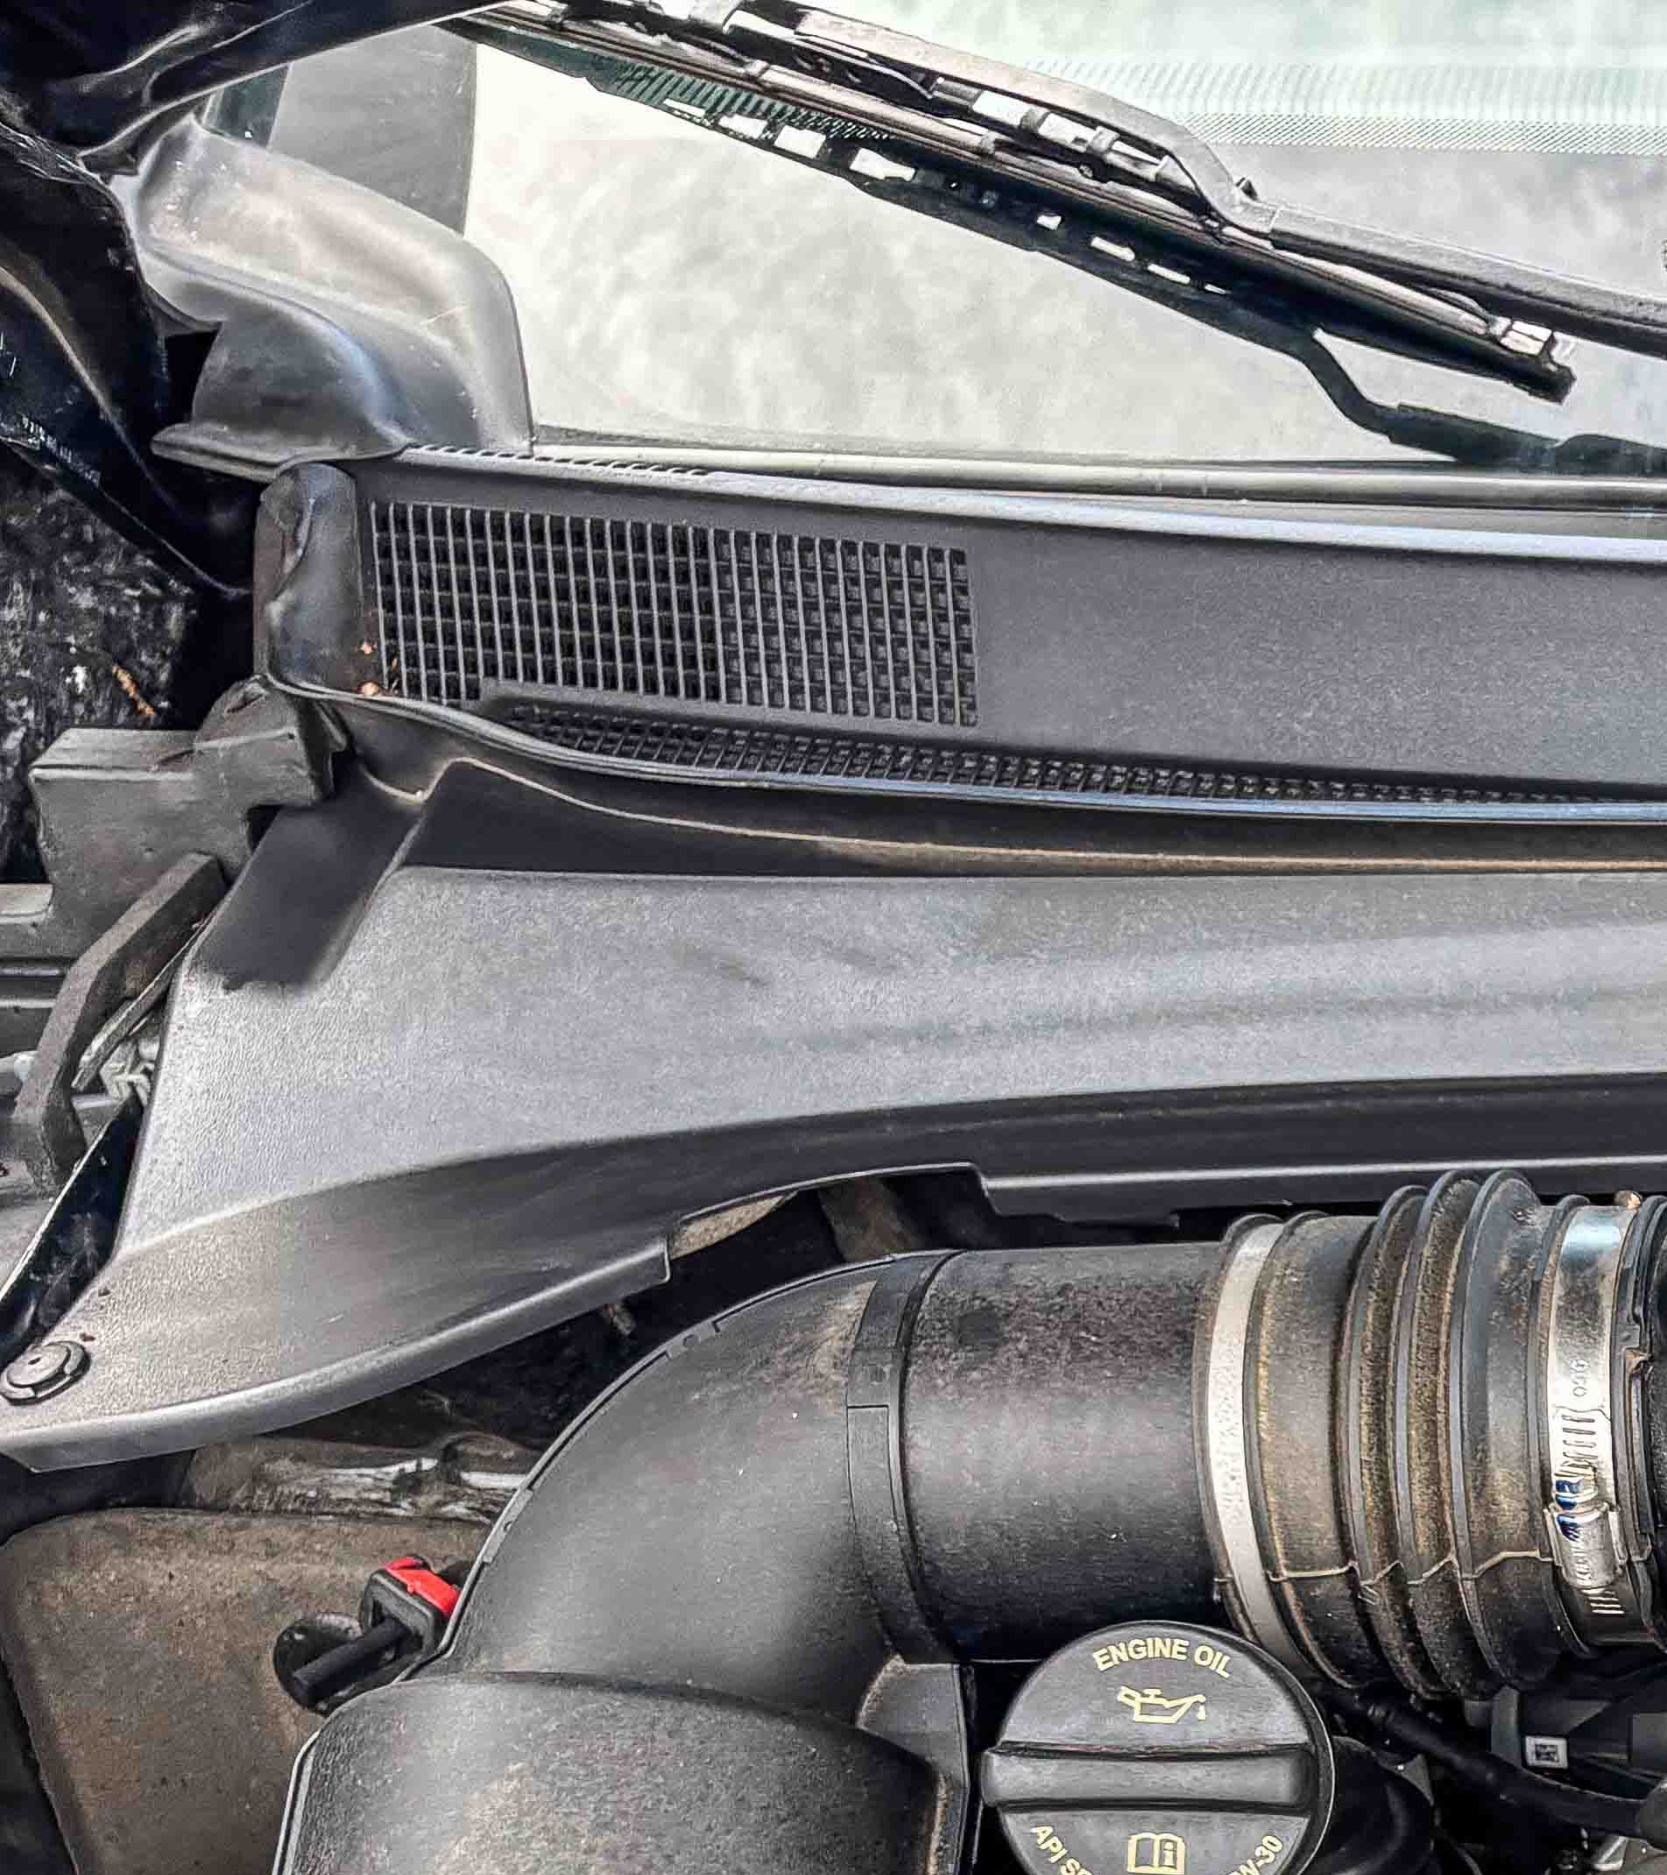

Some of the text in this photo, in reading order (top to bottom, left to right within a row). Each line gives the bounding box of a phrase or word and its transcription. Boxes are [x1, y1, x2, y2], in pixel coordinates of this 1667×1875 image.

[1092, 1637, 1232, 1678] ENGINE OIL
[1030, 1824, 1068, 1864] API
